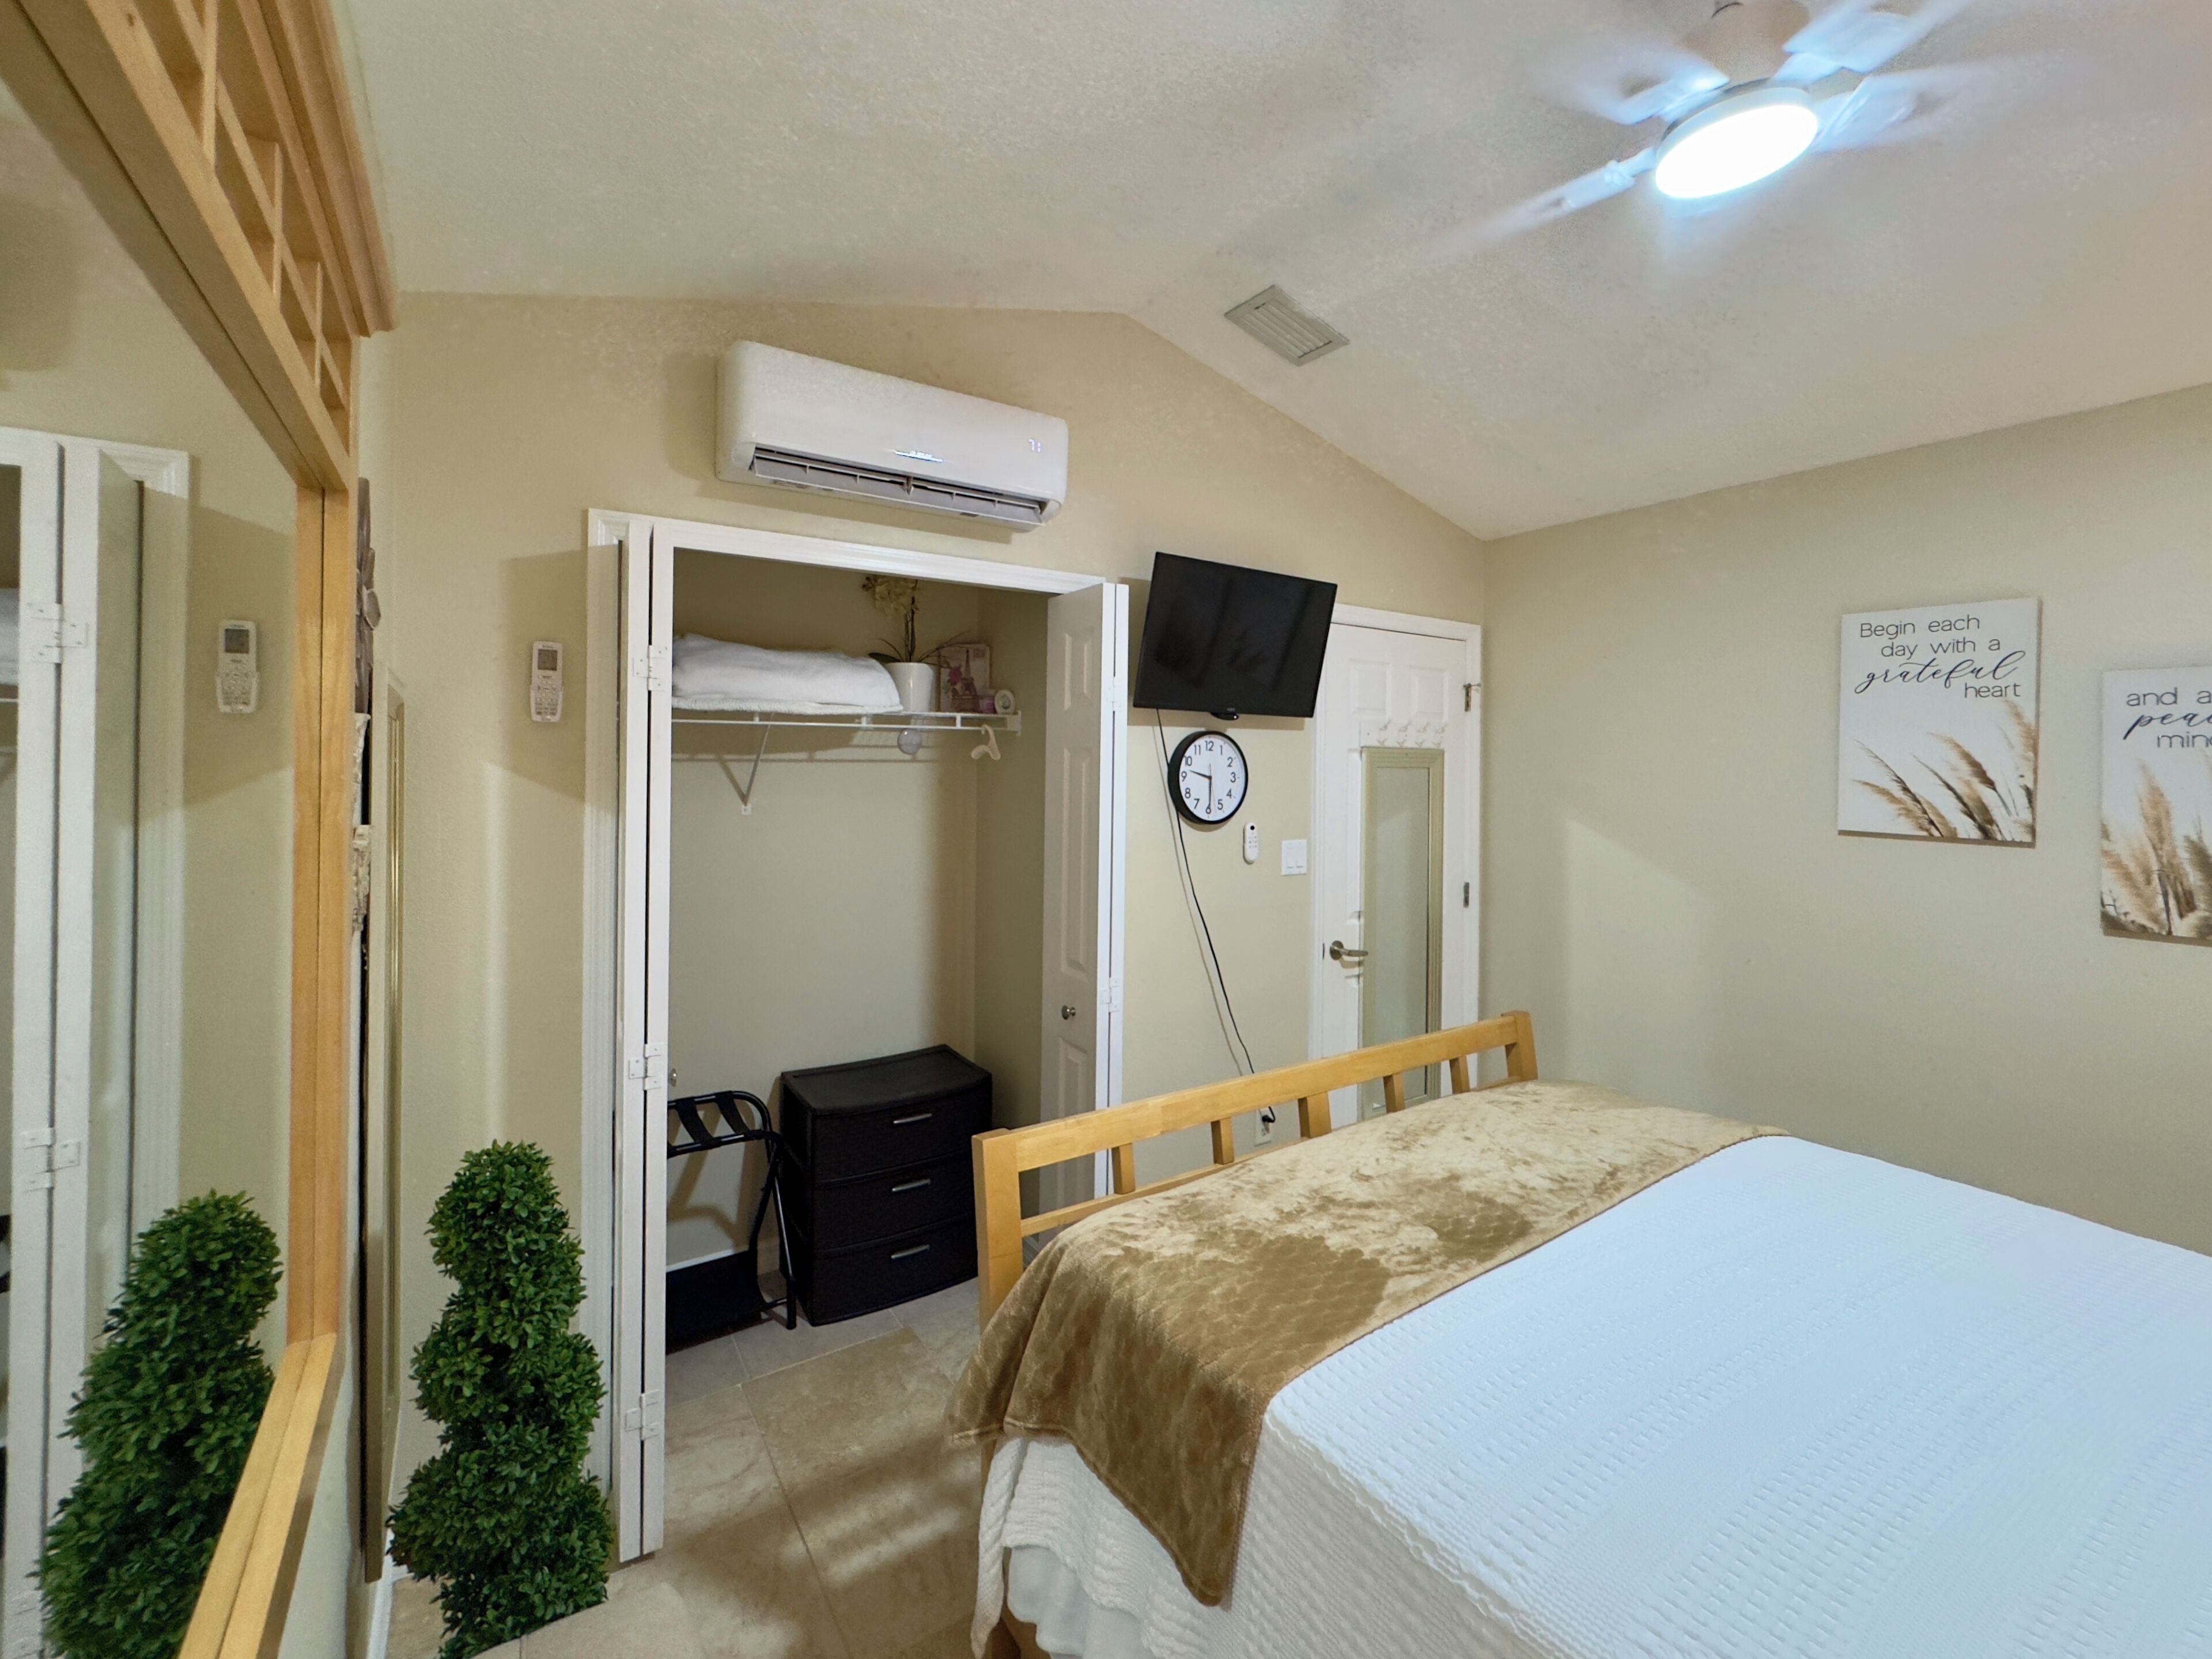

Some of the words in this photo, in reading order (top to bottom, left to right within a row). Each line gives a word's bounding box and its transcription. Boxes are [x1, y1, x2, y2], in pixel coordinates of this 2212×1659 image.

[1860, 621, 1916, 640] Begin
[1928, 614, 1980, 633] each
[1881, 642, 1918, 660] day
[1930, 637, 1976, 654] with
[1988, 638, 2001, 651] a
[1854, 651, 2026, 694] grateful
[1964, 682, 2021, 698] heart
[2126, 686, 2178, 706] and
[2196, 690, 2211, 704] a
[1205, 740, 1214, 751] 12
[2157, 731, 2212, 749] min
[1194, 745, 1201, 755] 11
[1219, 745, 1223, 755] 1
[1183, 755, 1193, 766] 10
[1227, 757, 1233, 767] 2
[1181, 771, 1187, 782] 9
[1230, 772, 1236, 783] 3
[1185, 788, 1191, 799] 8
[1226, 788, 1232, 799] 4
[1193, 799, 1200, 809] 7
[1205, 803, 1212, 814] 6
[1217, 799, 1223, 810] 5
